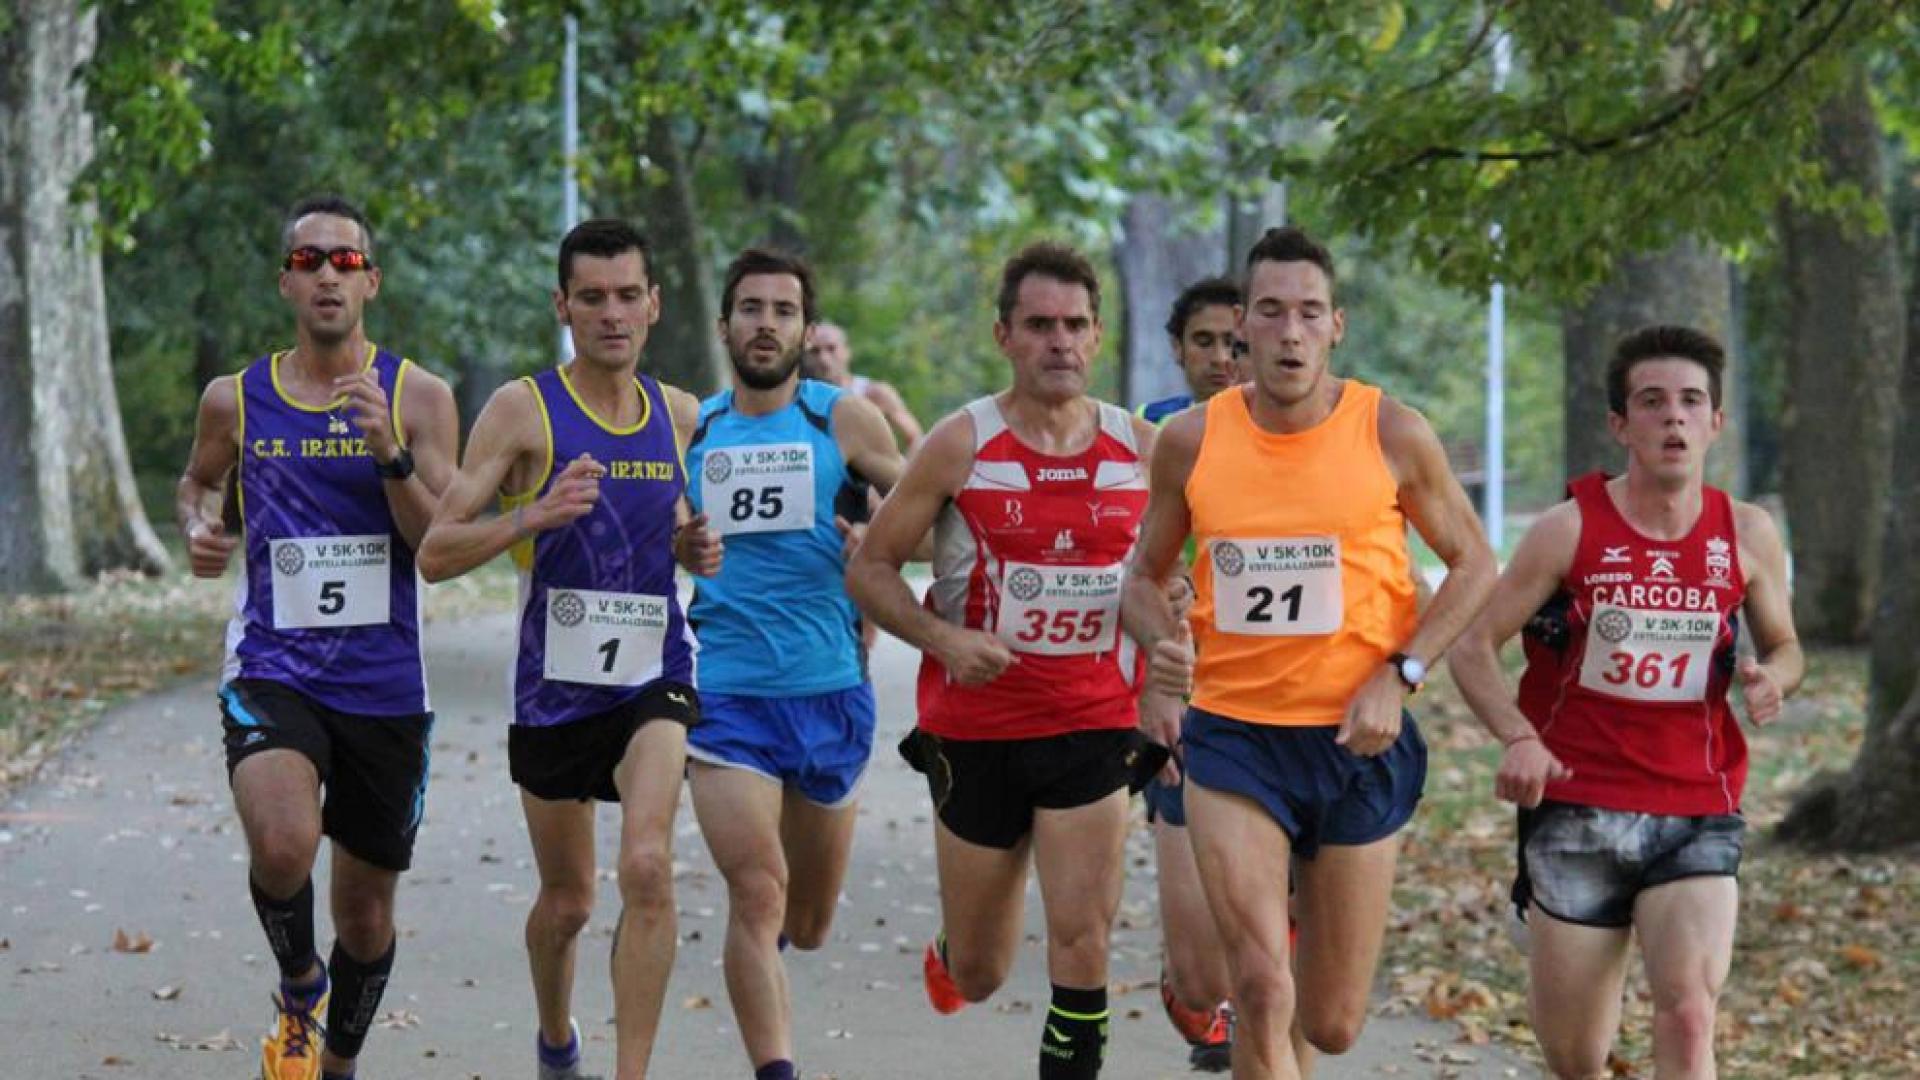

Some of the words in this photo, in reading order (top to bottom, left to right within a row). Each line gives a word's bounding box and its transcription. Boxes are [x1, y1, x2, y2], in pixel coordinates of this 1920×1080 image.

[254, 438, 291, 457] C.A.
[301, 438, 374, 457] IRANZ
[742, 451, 753, 464] V
[729, 486, 784, 521] 85
[316, 544, 327, 557] V
[1257, 547, 1269, 560] V
[1274, 544, 1335, 560] 5K-10K
[1056, 573, 1068, 587] V
[317, 581, 346, 615] 5
[599, 600, 609, 613] V
[1246, 585, 1304, 622] 21
[1592, 584, 1717, 611] CARCOBA
[1016, 608, 1105, 644] 355
[1646, 617, 1657, 630] V
[598, 638, 621, 673] 1
[1602, 652, 1692, 688] 361
